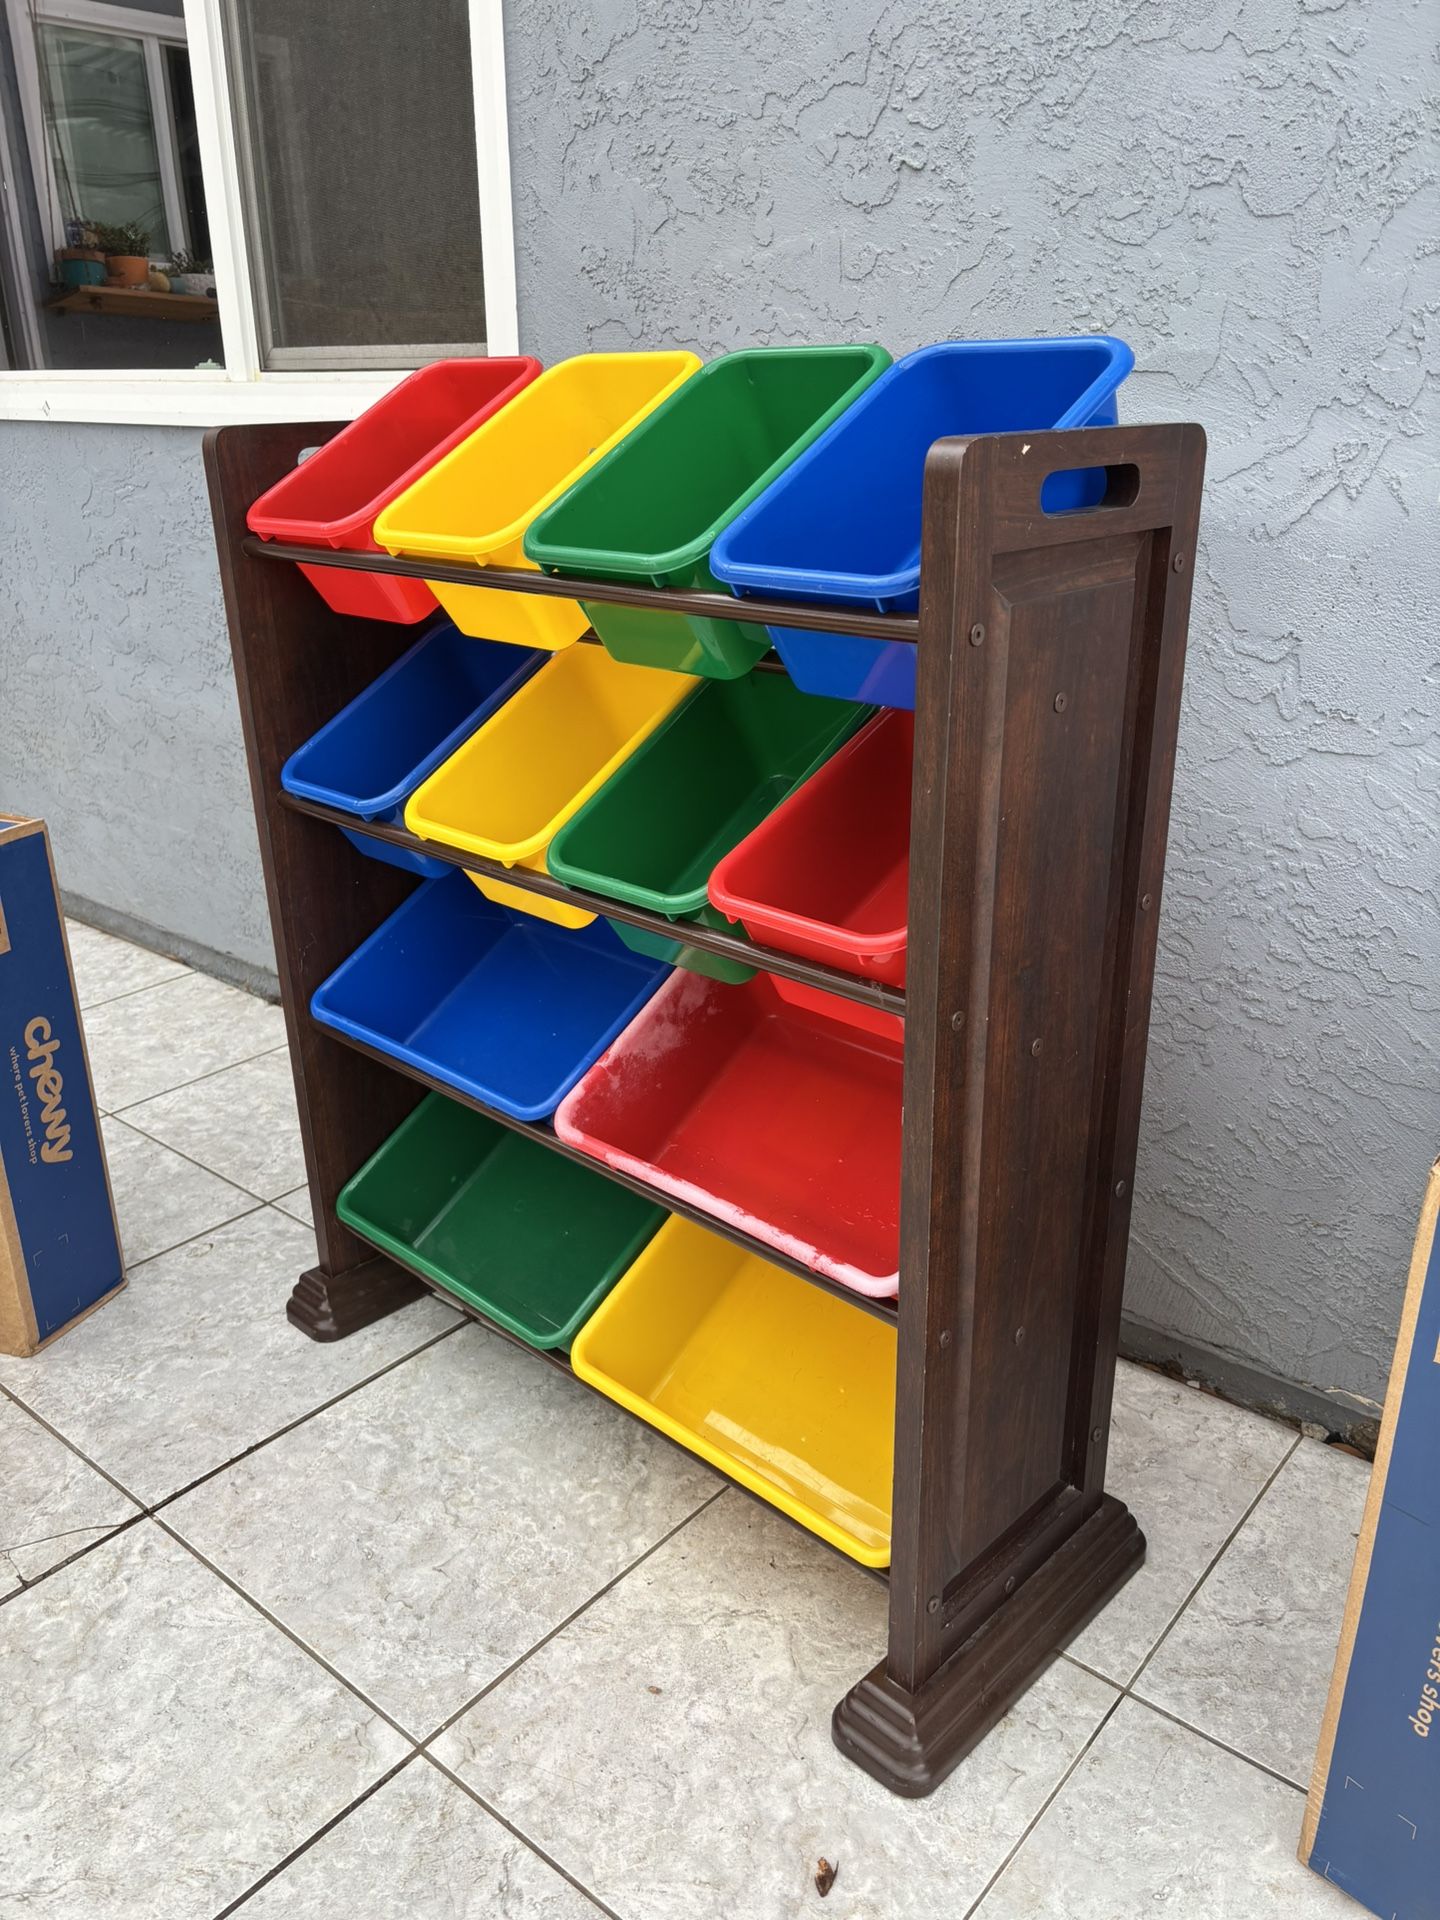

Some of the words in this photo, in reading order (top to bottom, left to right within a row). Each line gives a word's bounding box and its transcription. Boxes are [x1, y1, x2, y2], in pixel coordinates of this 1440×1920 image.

[9, 1046, 21, 1081] where
[14, 1083, 27, 1103] pet
[24, 1016, 73, 1163] chewy
[20, 1102, 33, 1136] lovers
[27, 1138, 38, 1165] shop
[1426, 1621, 1440, 1683] ers
[1408, 1683, 1440, 1737] shop
